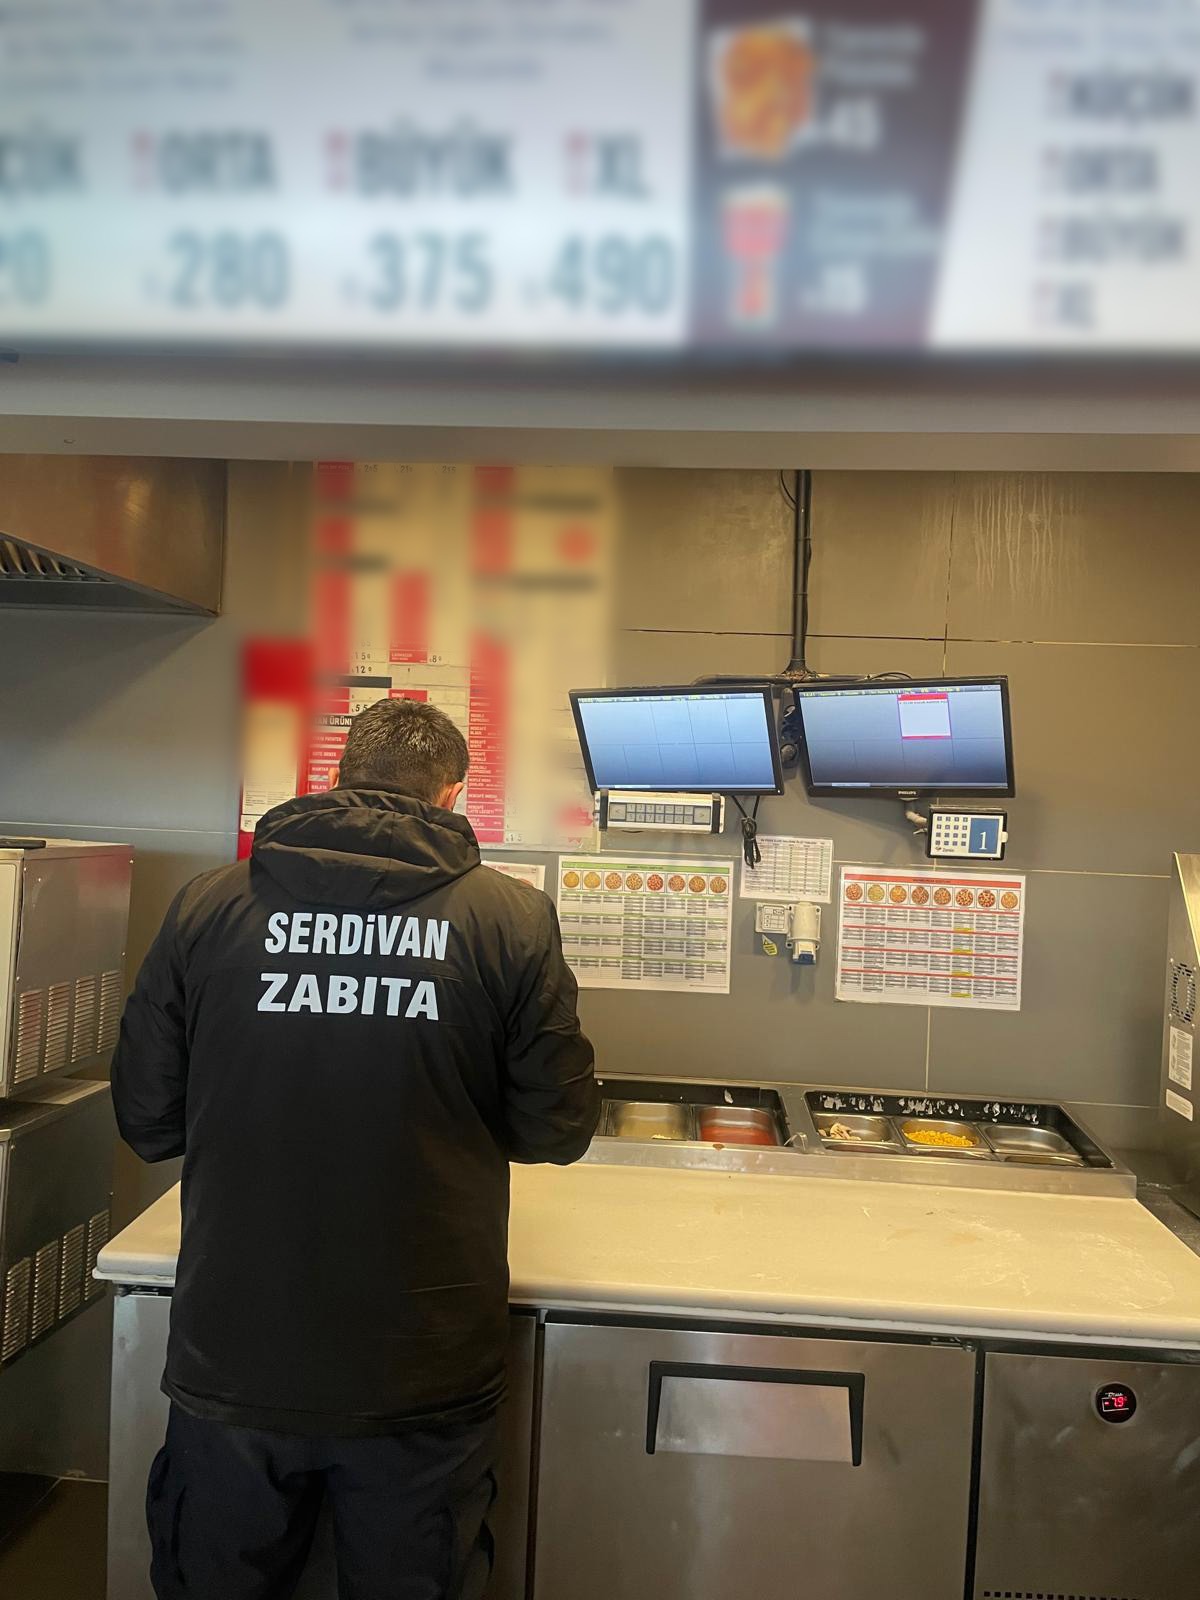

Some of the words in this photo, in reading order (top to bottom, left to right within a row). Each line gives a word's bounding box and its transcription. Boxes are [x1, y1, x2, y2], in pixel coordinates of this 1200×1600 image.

[168, 229, 291, 312] 280
[368, 231, 496, 315] 375
[547, 231, 678, 317] 490
[979, 831, 988, 850] 1
[257, 973, 440, 1021] ZABITA
